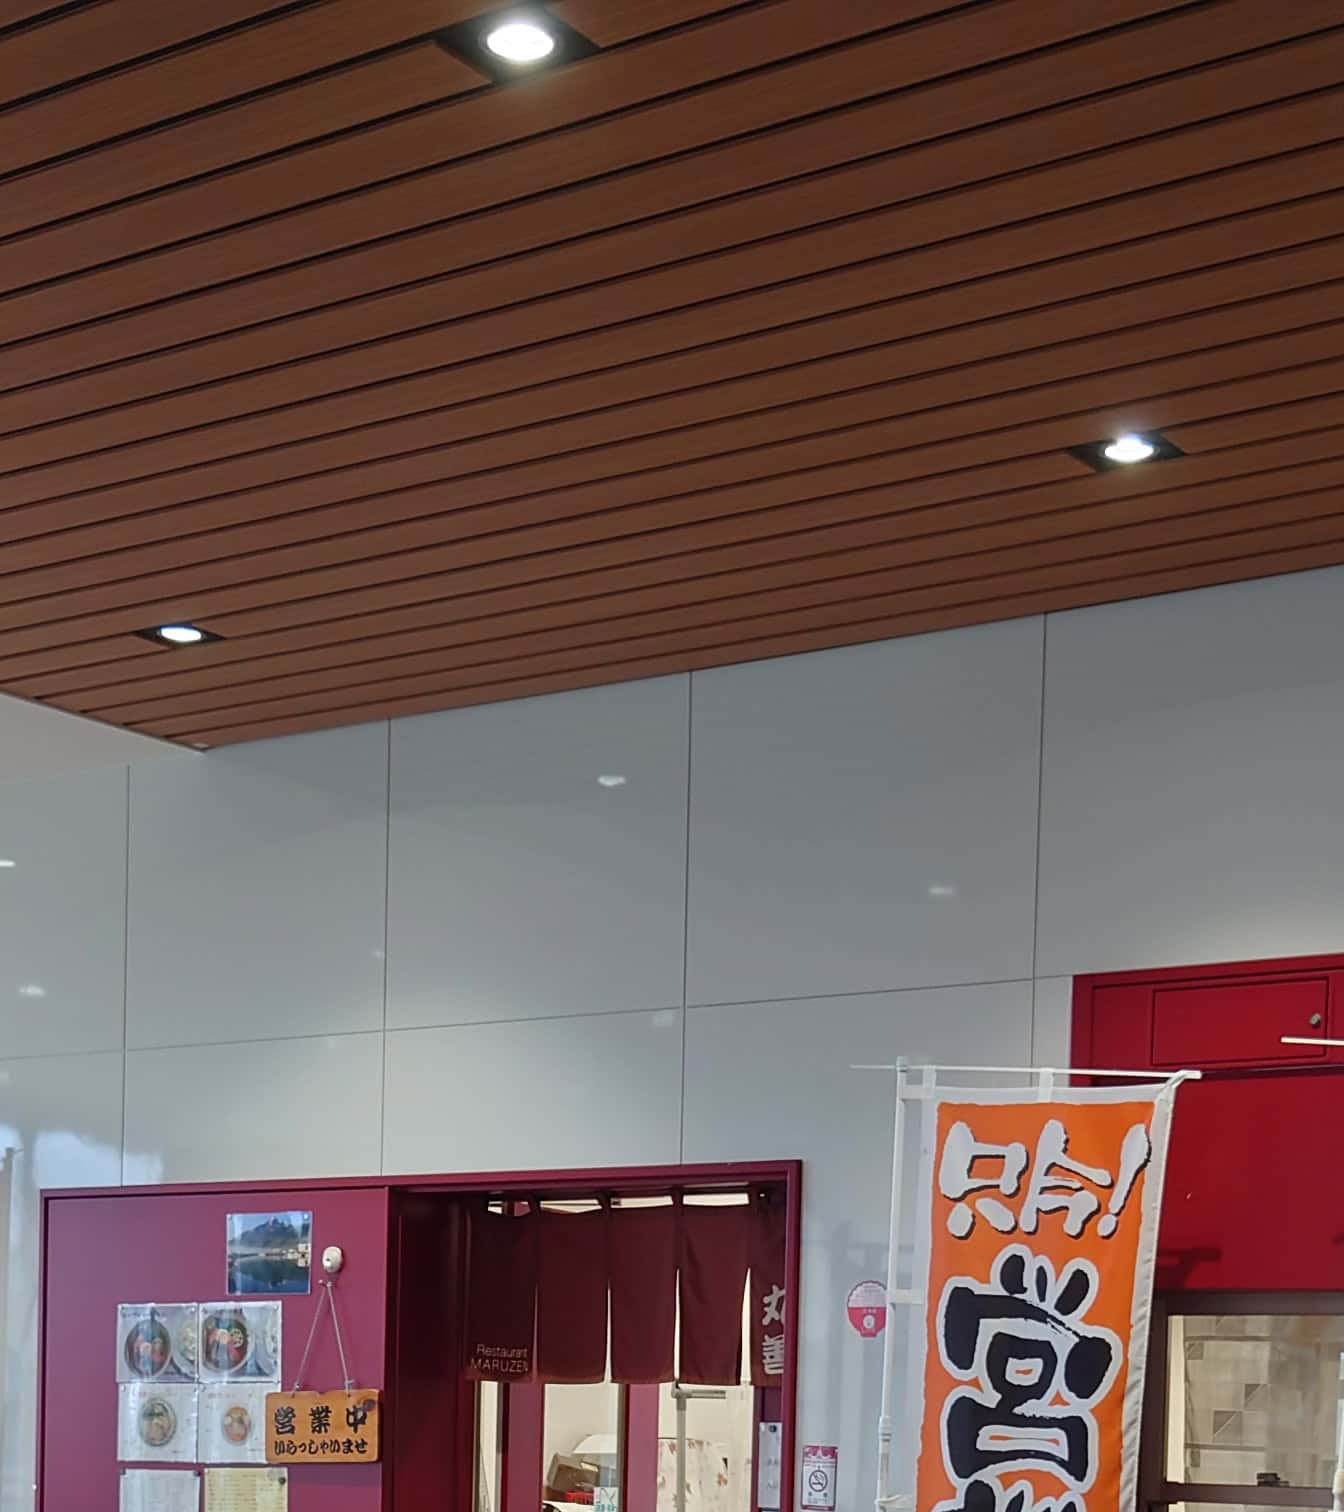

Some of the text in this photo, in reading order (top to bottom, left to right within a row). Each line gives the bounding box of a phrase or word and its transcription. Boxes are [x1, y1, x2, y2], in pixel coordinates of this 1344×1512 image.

[476, 1344, 528, 1358] Restaurant
[274, 1406, 368, 1435] 営業中
[274, 1439, 369, 1455] いらっしゃいませ
